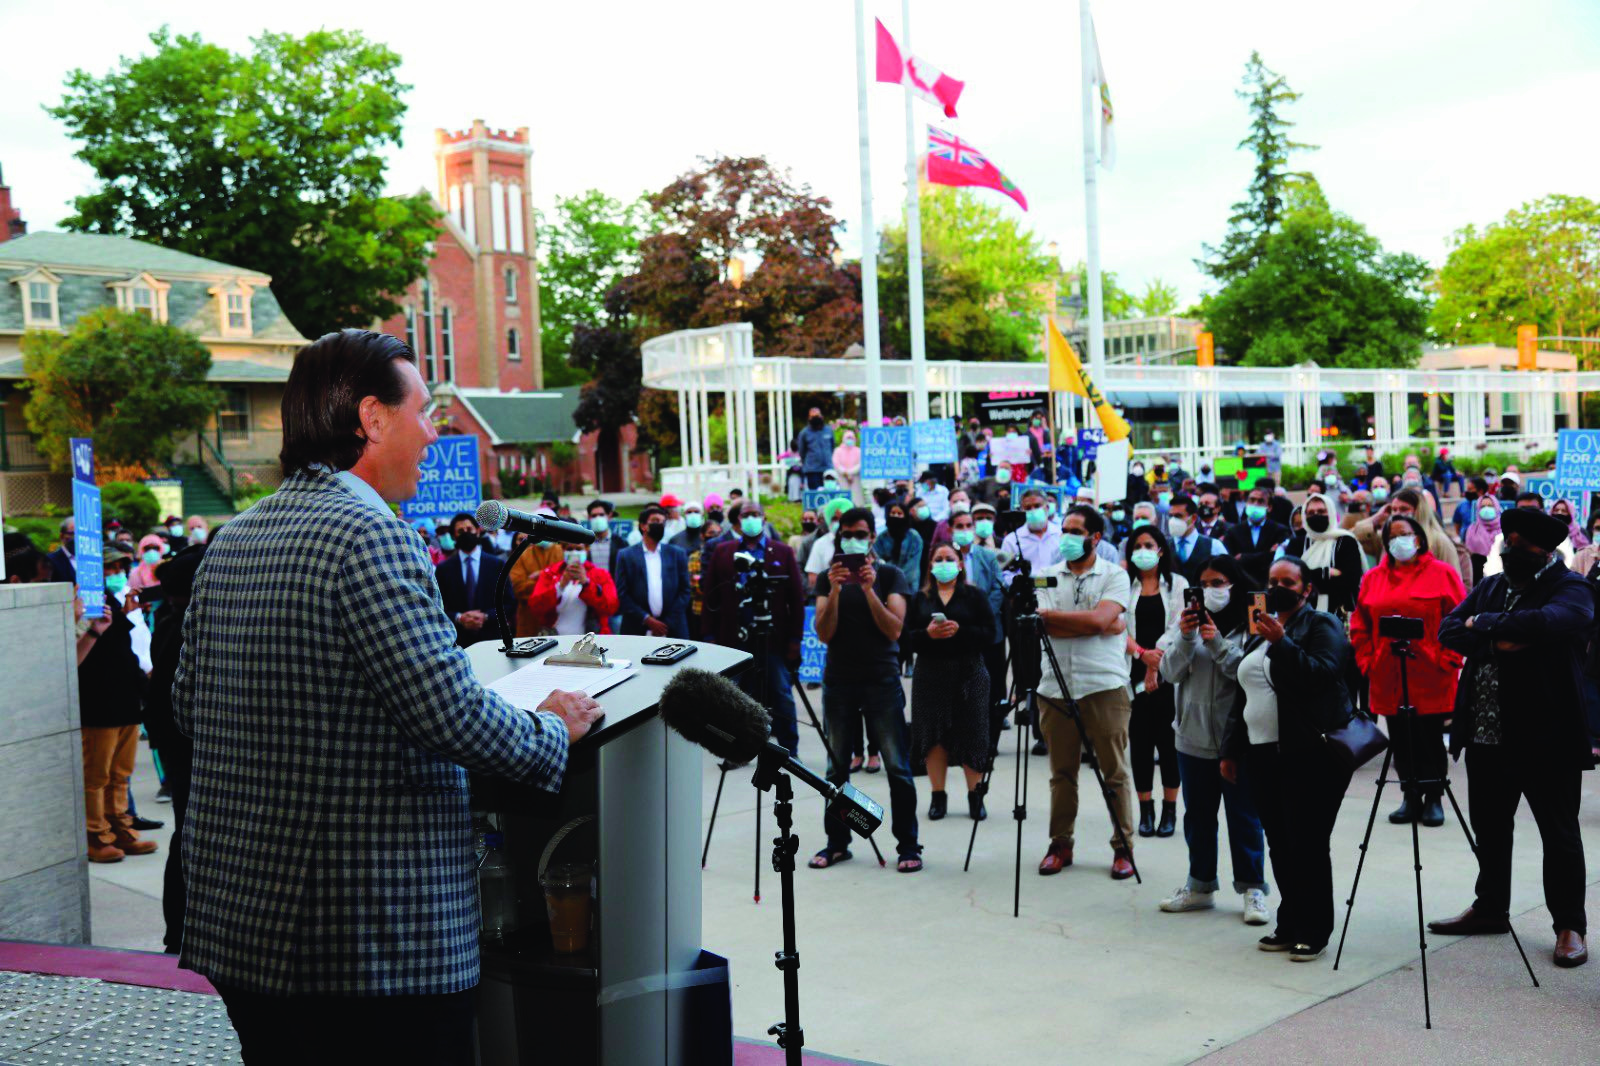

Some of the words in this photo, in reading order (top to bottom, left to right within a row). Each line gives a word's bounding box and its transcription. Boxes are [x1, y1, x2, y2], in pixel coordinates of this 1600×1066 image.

[864, 430, 909, 448] LOVE
[421, 442, 473, 468] OVE
[864, 448, 887, 457] FOR
[889, 448, 909, 456] ALL
[1563, 453, 1590, 464] FOR
[420, 469, 440, 482] OR
[444, 467, 475, 481] ALL
[1560, 478, 1583, 487] FOR
[407, 502, 436, 514] FOR
[439, 500, 477, 512] NONE
[846, 812, 870, 830] Global
